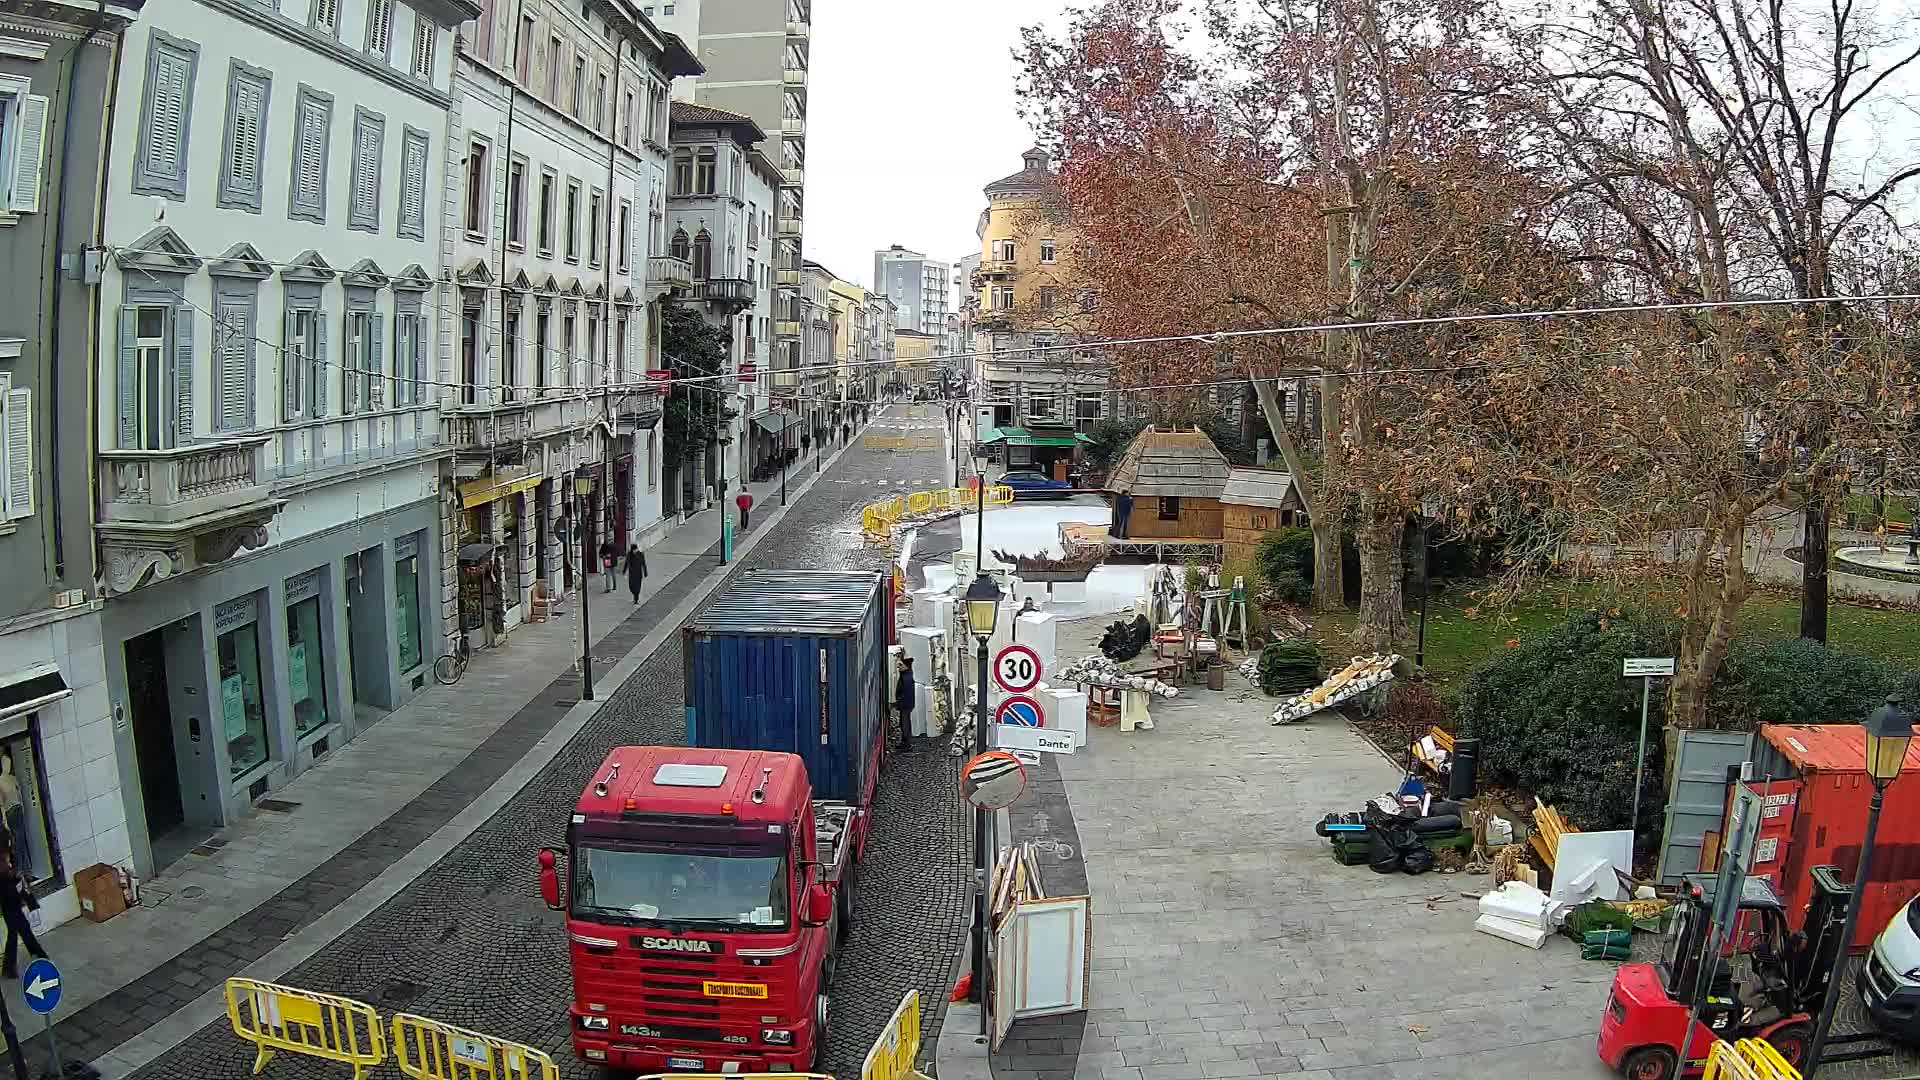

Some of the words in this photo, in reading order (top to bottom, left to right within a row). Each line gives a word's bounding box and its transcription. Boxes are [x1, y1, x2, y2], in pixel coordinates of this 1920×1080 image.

[1004, 658, 1032, 680] 30
[1038, 738, 1070, 749] Dante
[642, 936, 712, 953] SCANIA
[723, 1035, 748, 1044] 420
